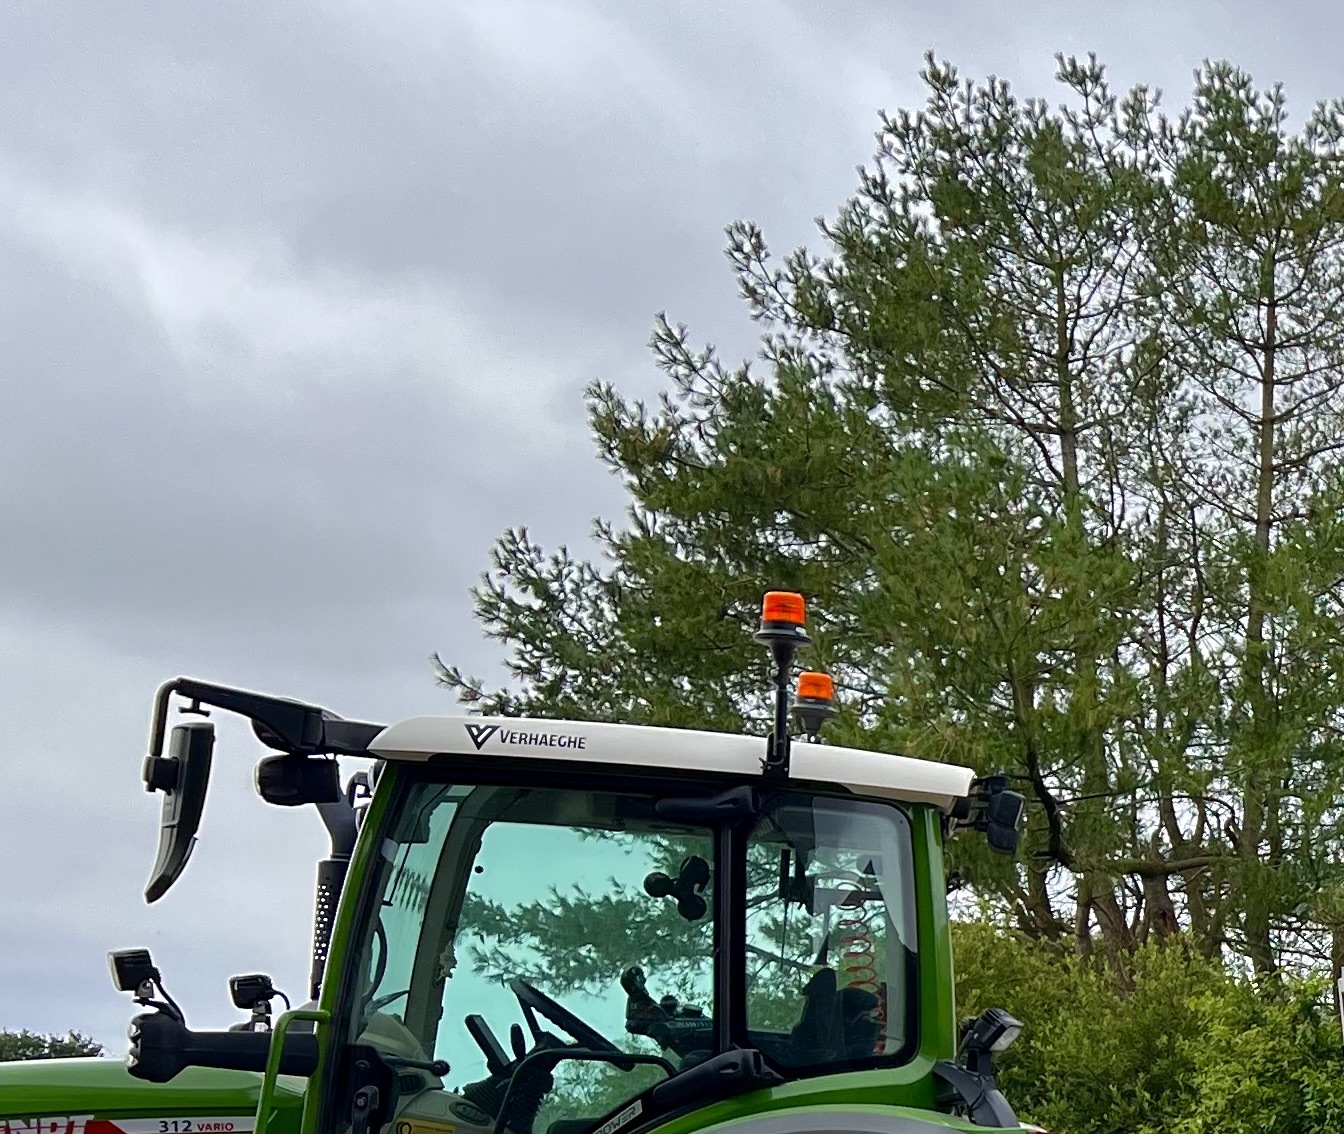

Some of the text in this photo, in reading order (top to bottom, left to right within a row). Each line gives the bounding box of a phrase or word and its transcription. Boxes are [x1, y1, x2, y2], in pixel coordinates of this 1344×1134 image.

[500, 729, 587, 749] VERHAEGHE
[159, 1120, 234, 1133] 312 VARIO
